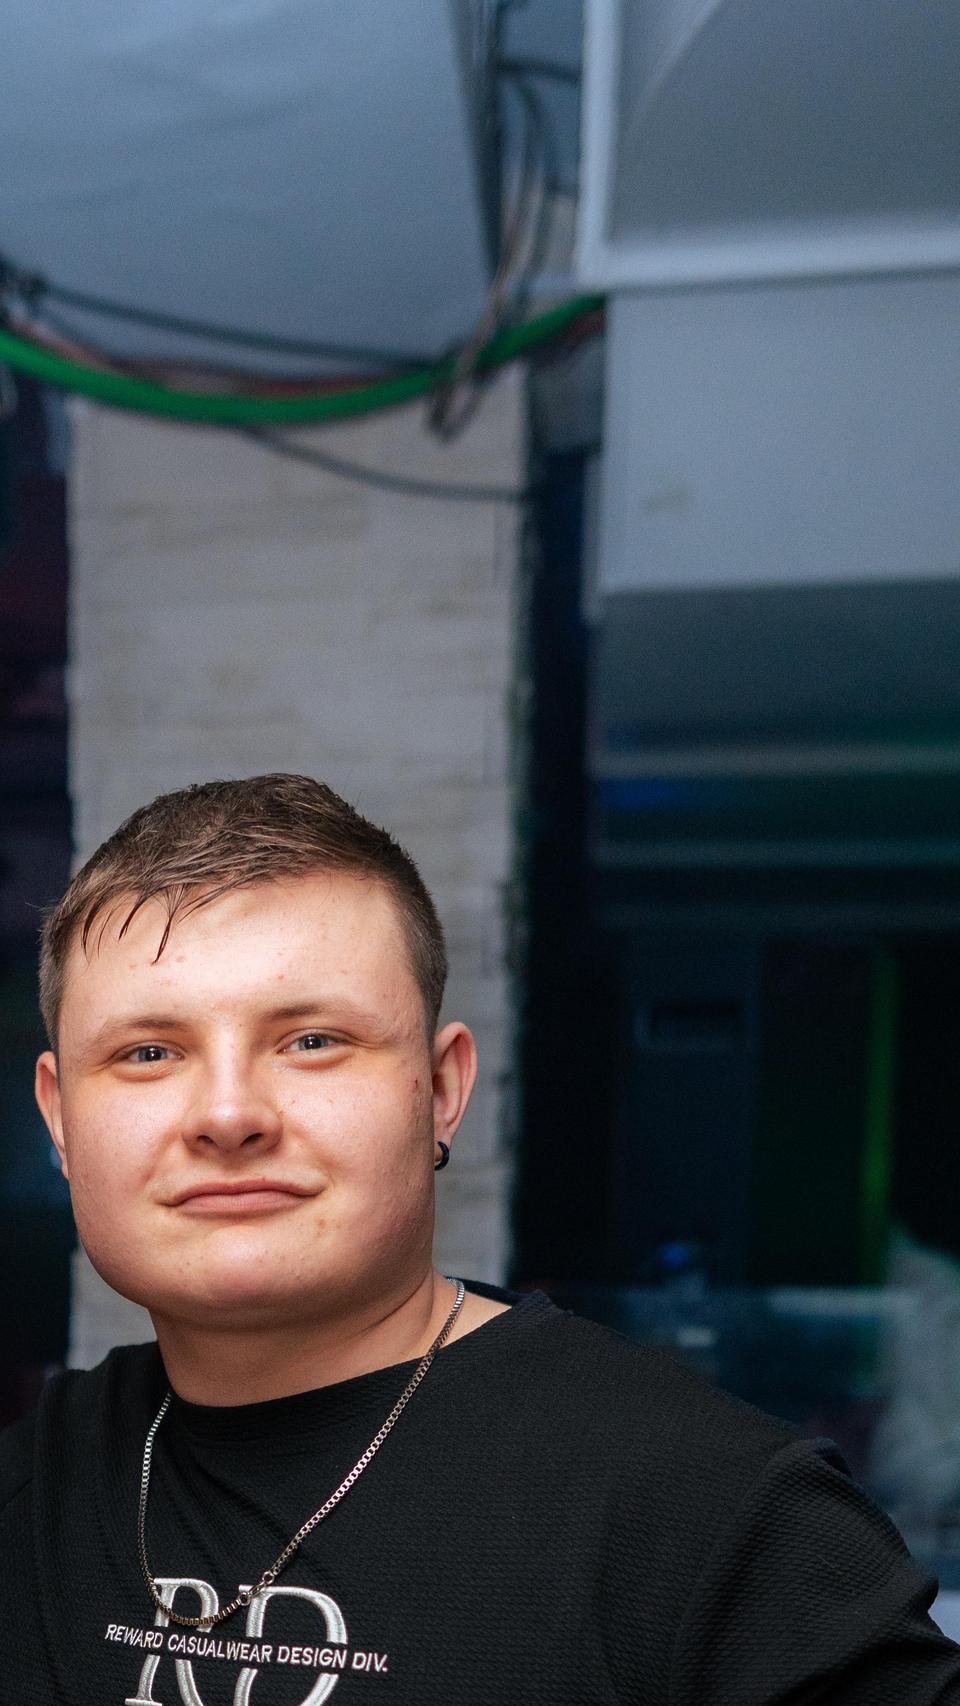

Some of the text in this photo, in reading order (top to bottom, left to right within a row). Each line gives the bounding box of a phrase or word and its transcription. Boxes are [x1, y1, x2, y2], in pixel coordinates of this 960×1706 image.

[104, 1623, 388, 1673] REWARD CASUALWEAR DESIGN DIV.
